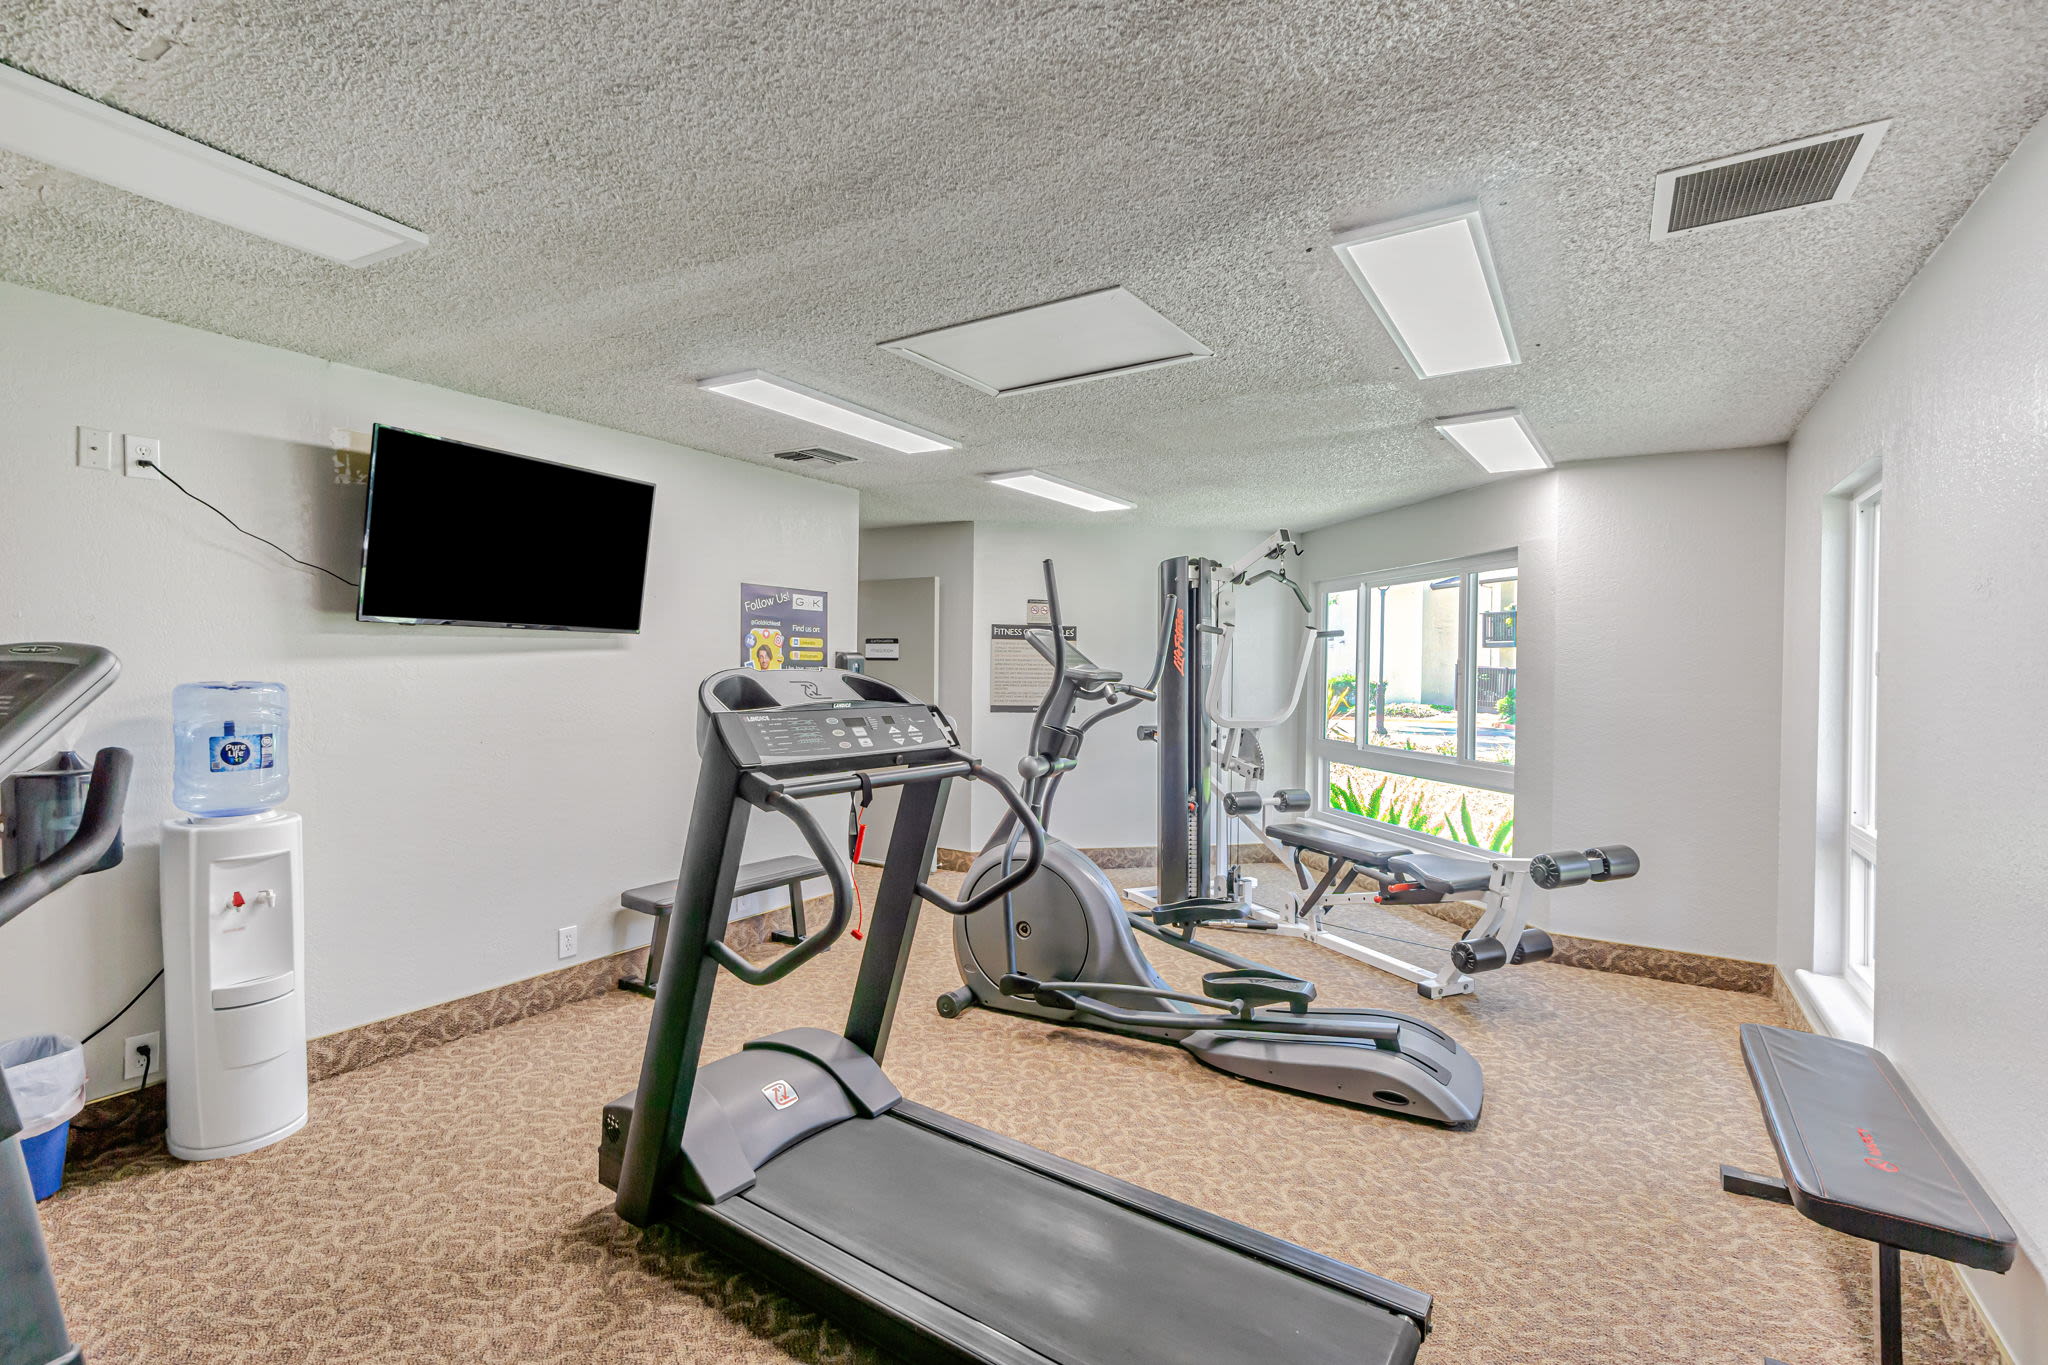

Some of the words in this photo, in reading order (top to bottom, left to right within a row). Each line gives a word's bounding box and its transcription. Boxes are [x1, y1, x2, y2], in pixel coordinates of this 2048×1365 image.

[744, 597, 774, 612] Follow
[776, 592, 790, 603] Us!
[792, 624, 804, 632] Find
[994, 627, 1022, 636] FITNESS
[228, 750, 244, 758] Life
